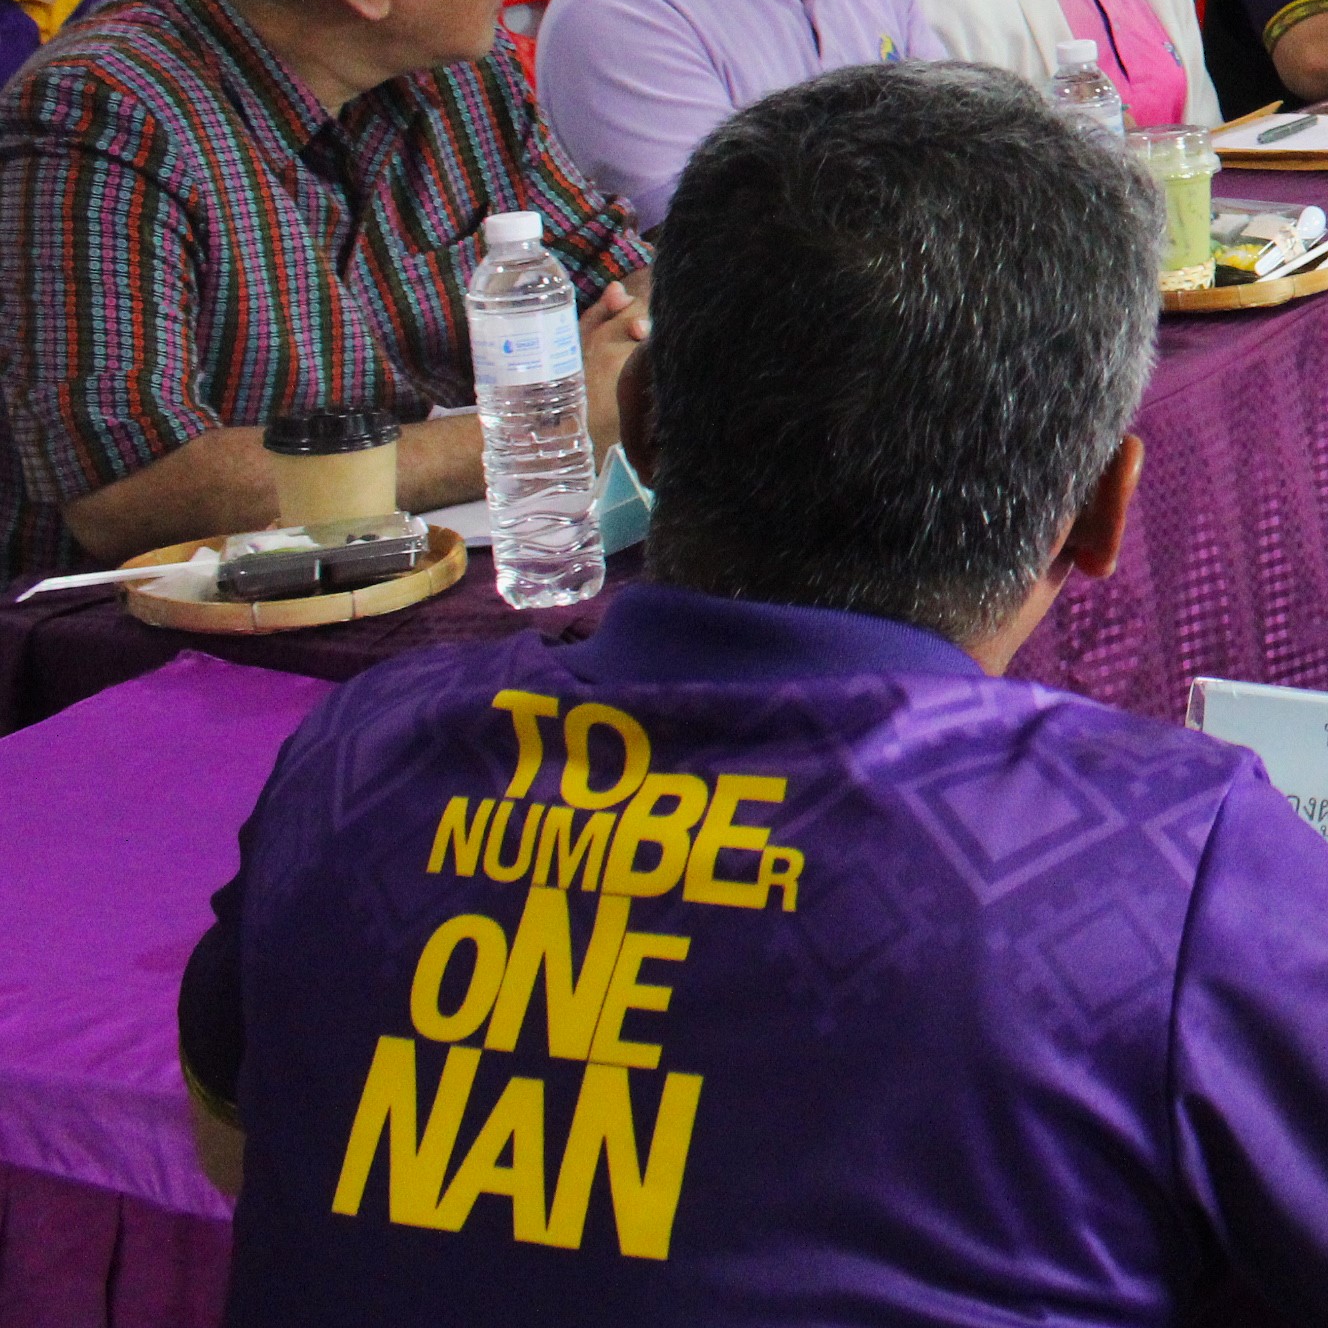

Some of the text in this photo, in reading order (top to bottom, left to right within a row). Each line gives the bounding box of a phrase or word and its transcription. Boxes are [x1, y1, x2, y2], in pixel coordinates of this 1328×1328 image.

[490, 689, 786, 910] TO BE
[409, 886, 691, 1070] ONE
[331, 1035, 704, 1262] NAN
